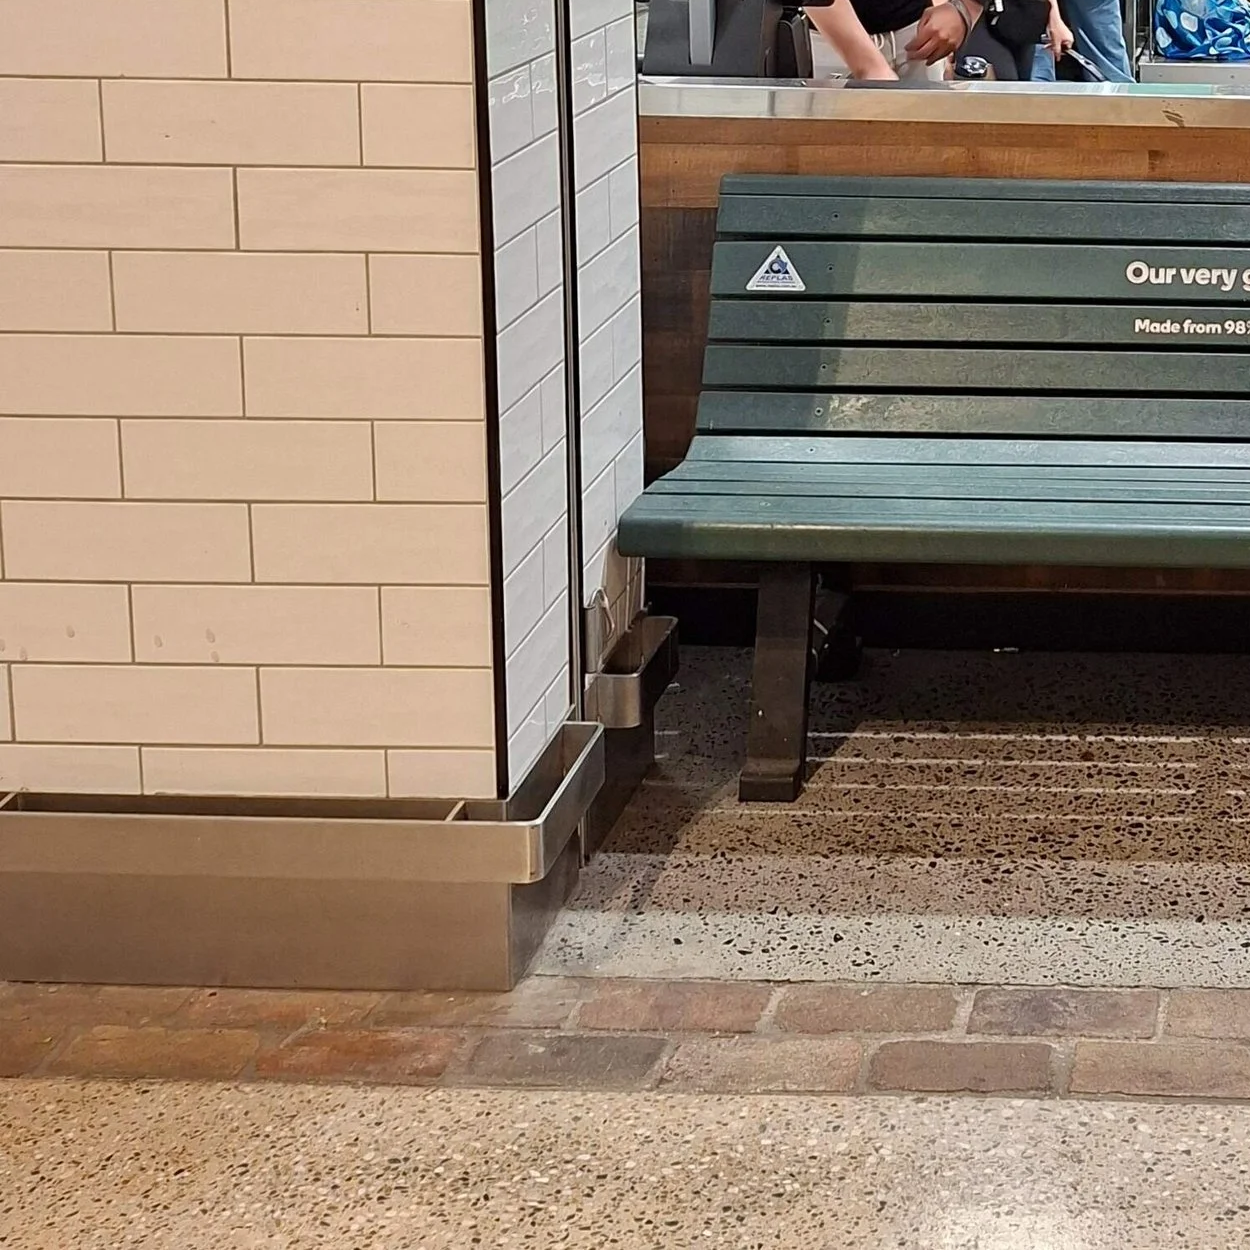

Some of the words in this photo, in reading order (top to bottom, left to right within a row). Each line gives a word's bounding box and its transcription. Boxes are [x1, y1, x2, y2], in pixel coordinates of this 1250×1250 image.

[1126, 261, 1176, 285] Our
[1180, 267, 1237, 291] very
[1134, 318, 1180, 334] Made
[1183, 319, 1222, 334] from
